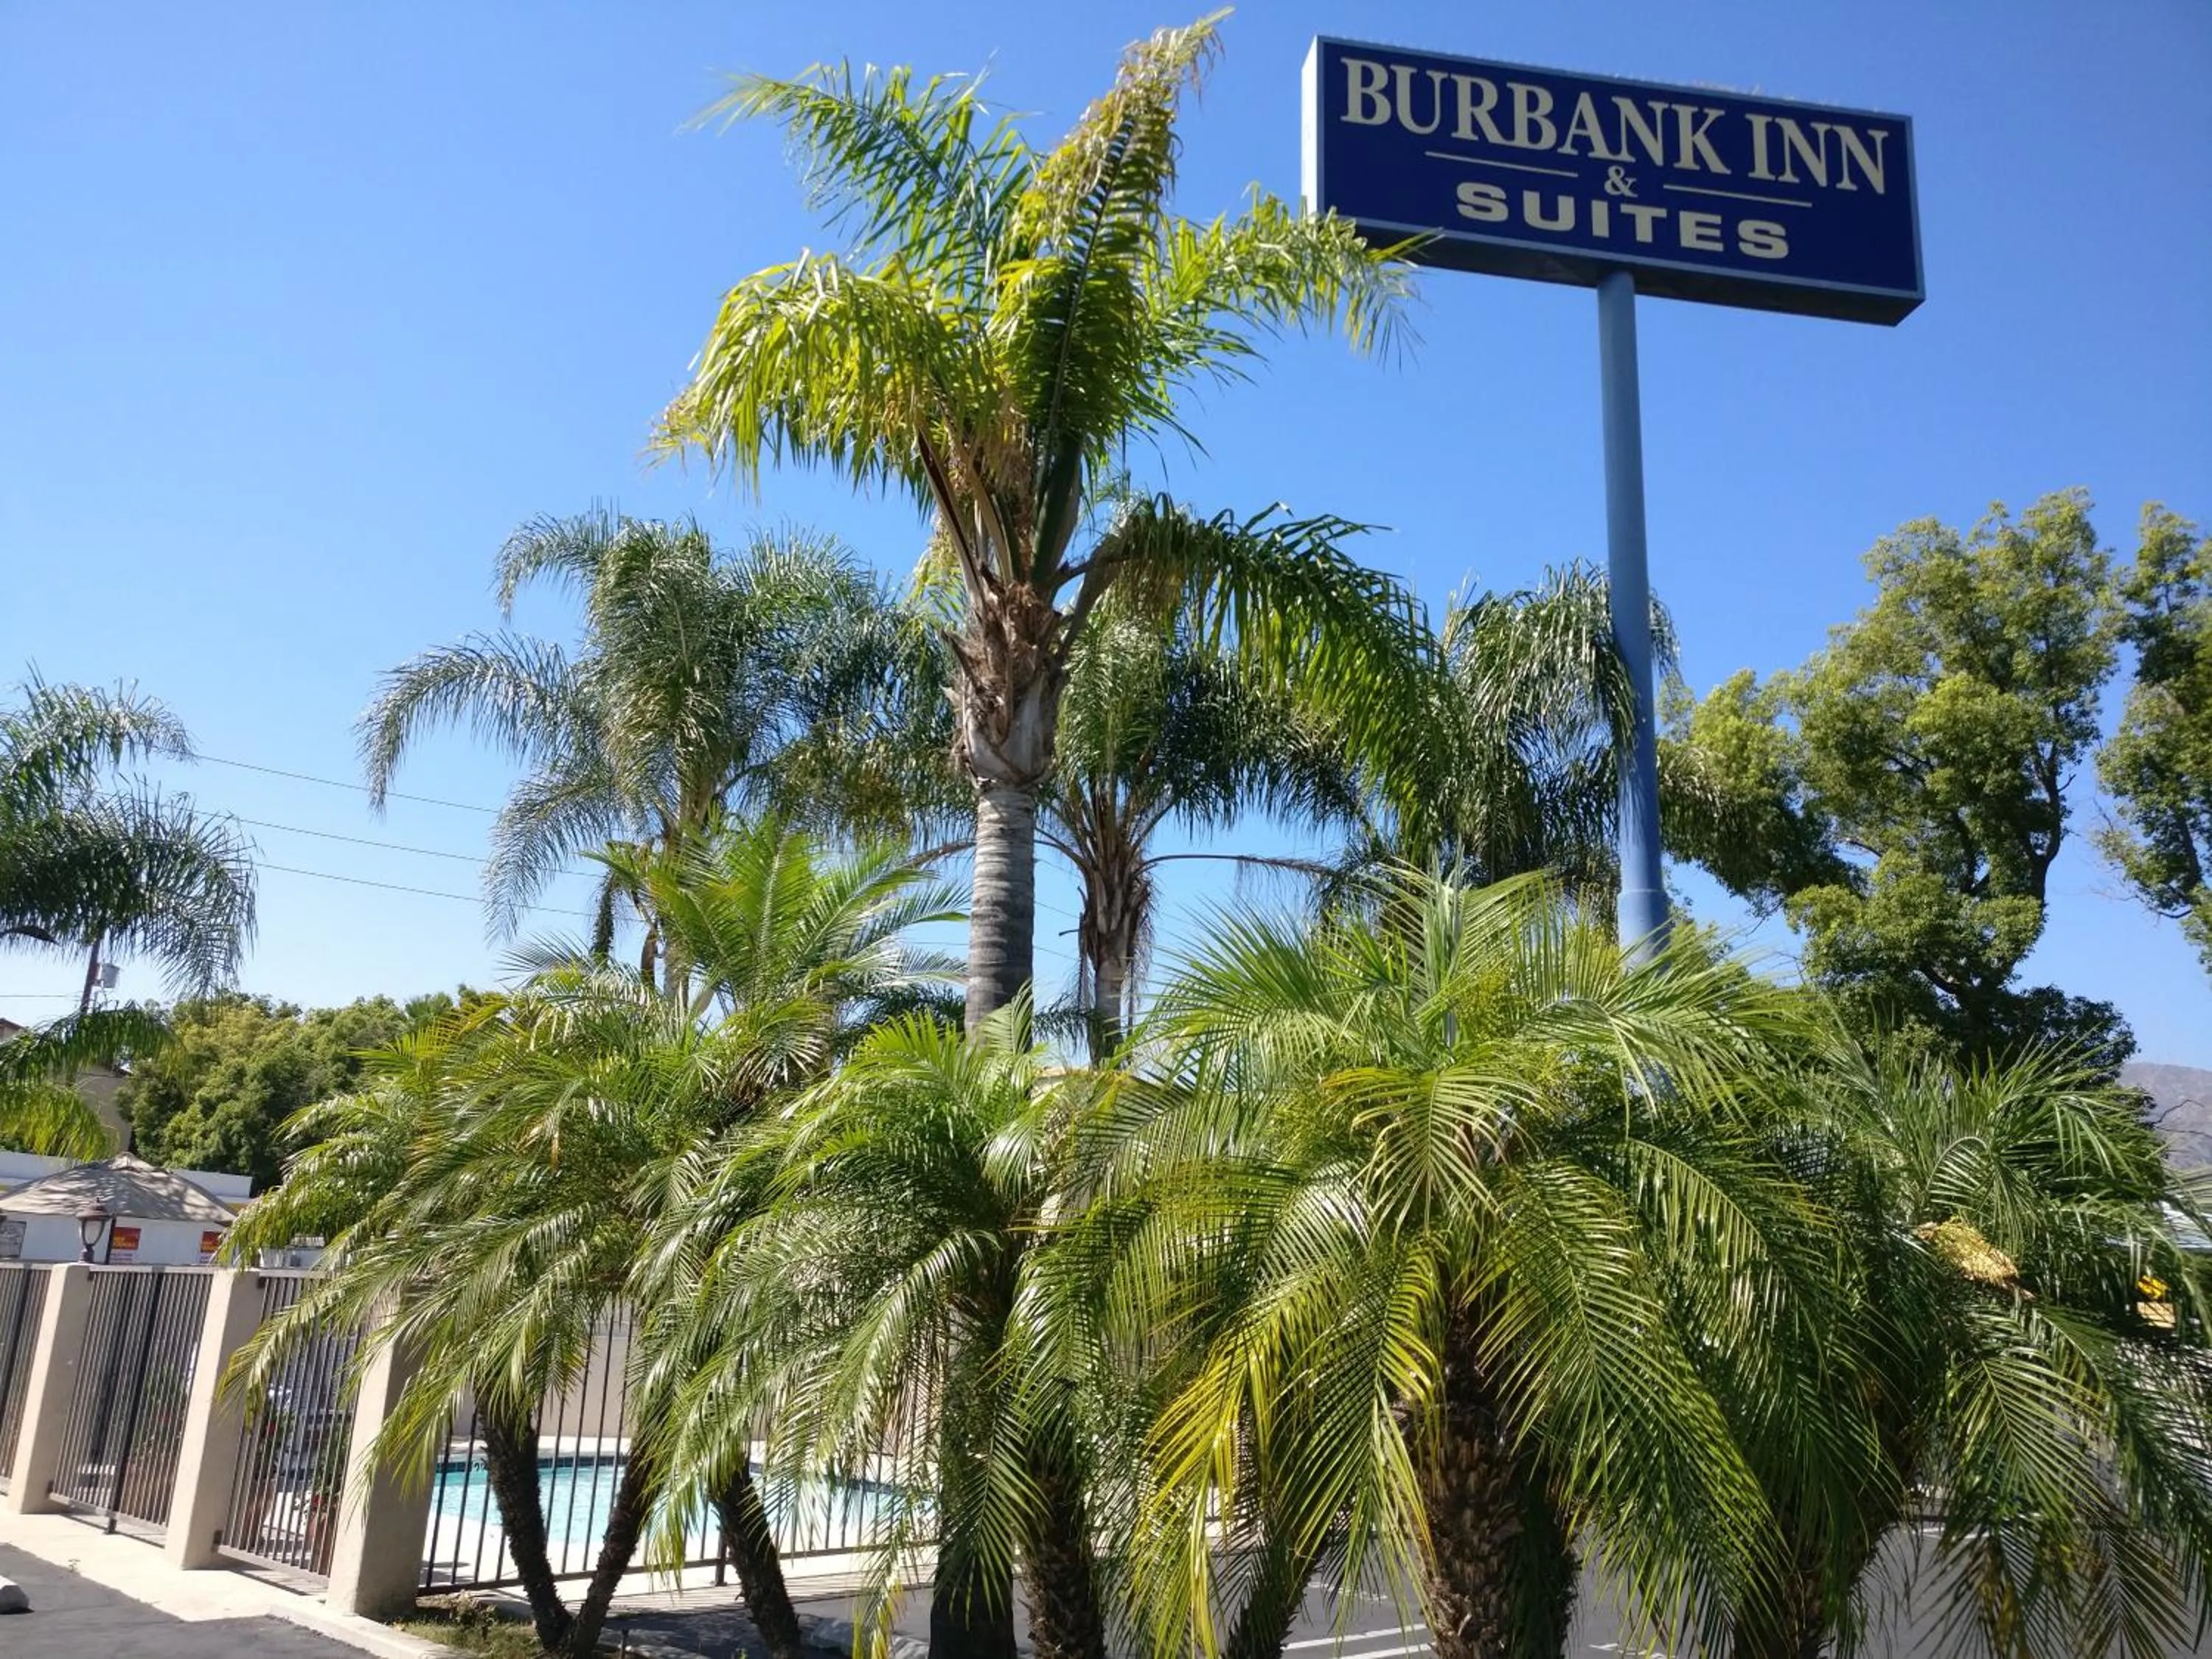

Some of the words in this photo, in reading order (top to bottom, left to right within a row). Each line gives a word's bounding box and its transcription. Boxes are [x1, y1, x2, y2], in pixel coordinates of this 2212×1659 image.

[1340, 57, 1731, 175] BURBANK
[1745, 114, 1888, 195] INN
[1455, 181, 1790, 259] SUITES
[1604, 164, 1638, 198] &
